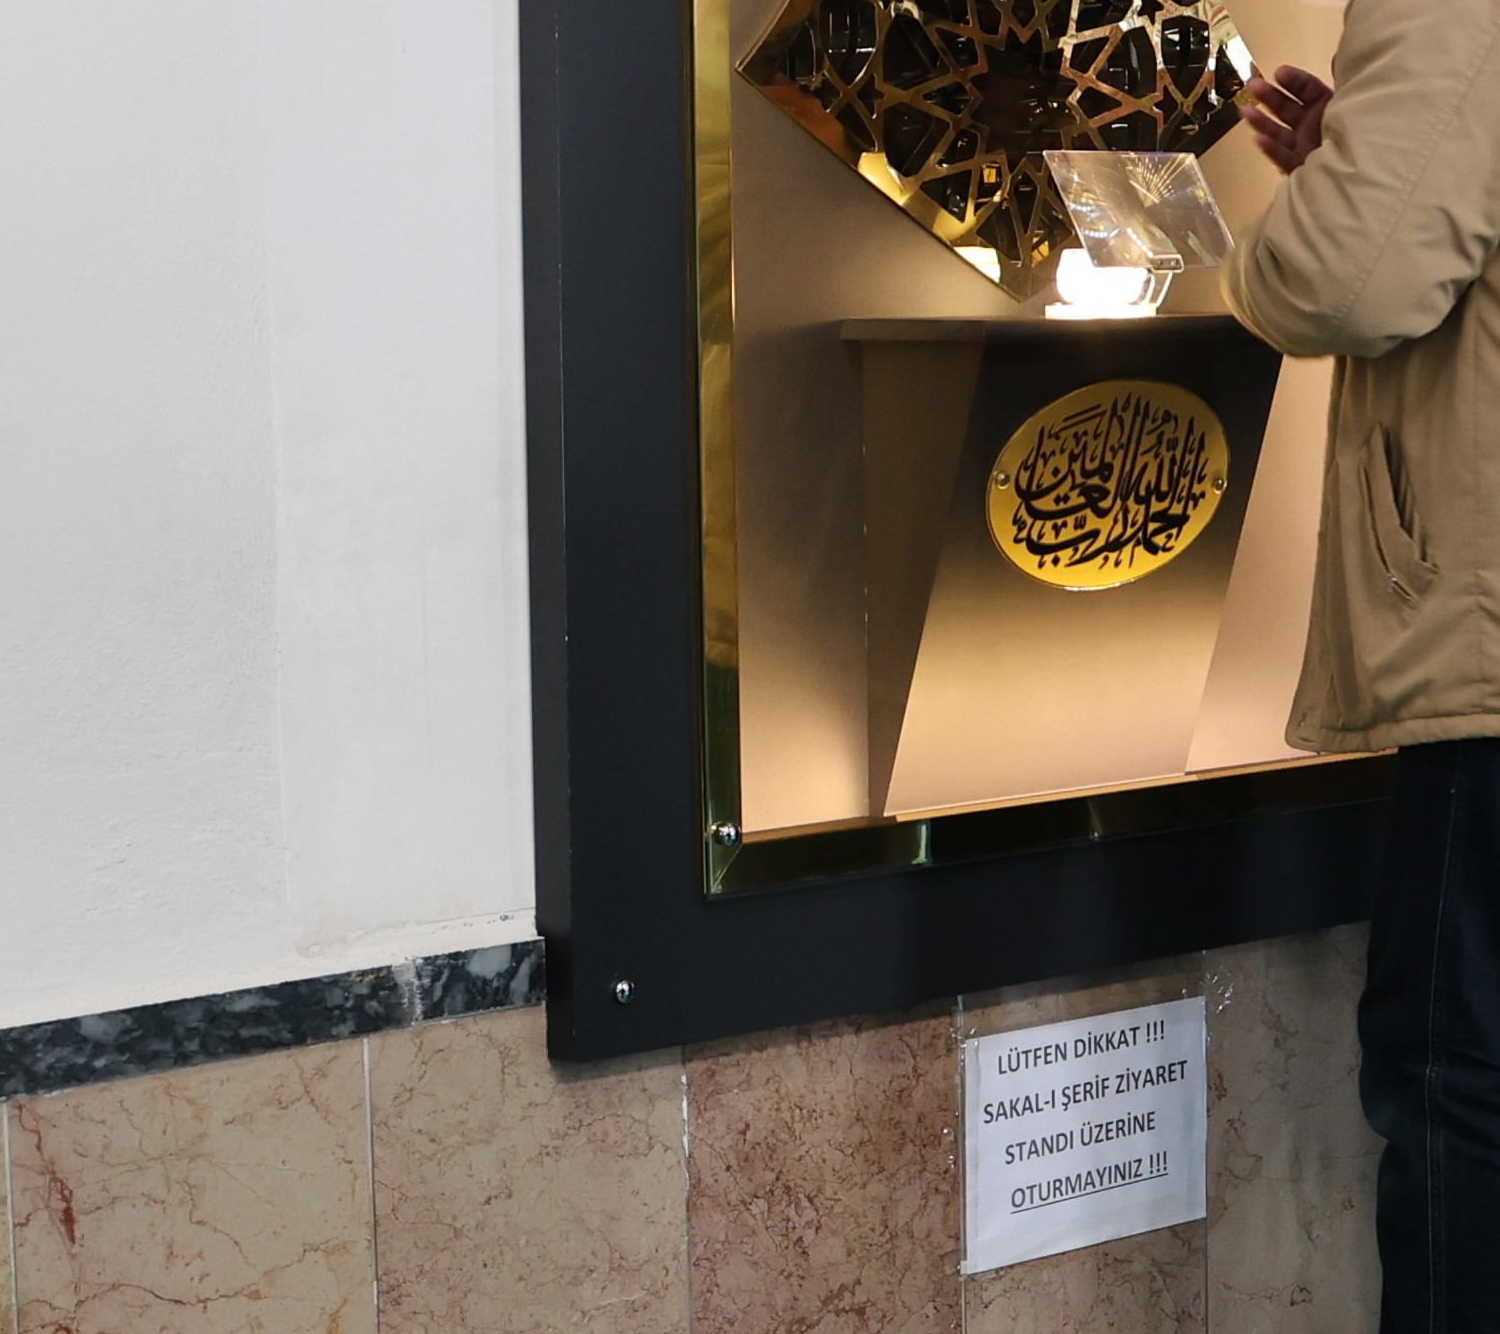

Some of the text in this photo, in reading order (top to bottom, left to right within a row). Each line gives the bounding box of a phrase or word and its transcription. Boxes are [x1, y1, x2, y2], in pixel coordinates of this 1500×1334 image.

[997, 1019, 1166, 1075] LÜTFEN DİKKAT !!!
[983, 1059, 1188, 1125] SAKAL-I ŞERİF ZİYARET
[1004, 1110, 1156, 1165] STANDI ÜZERİNE
[1011, 1150, 1168, 1209] OTURMAYINIZ !!!
